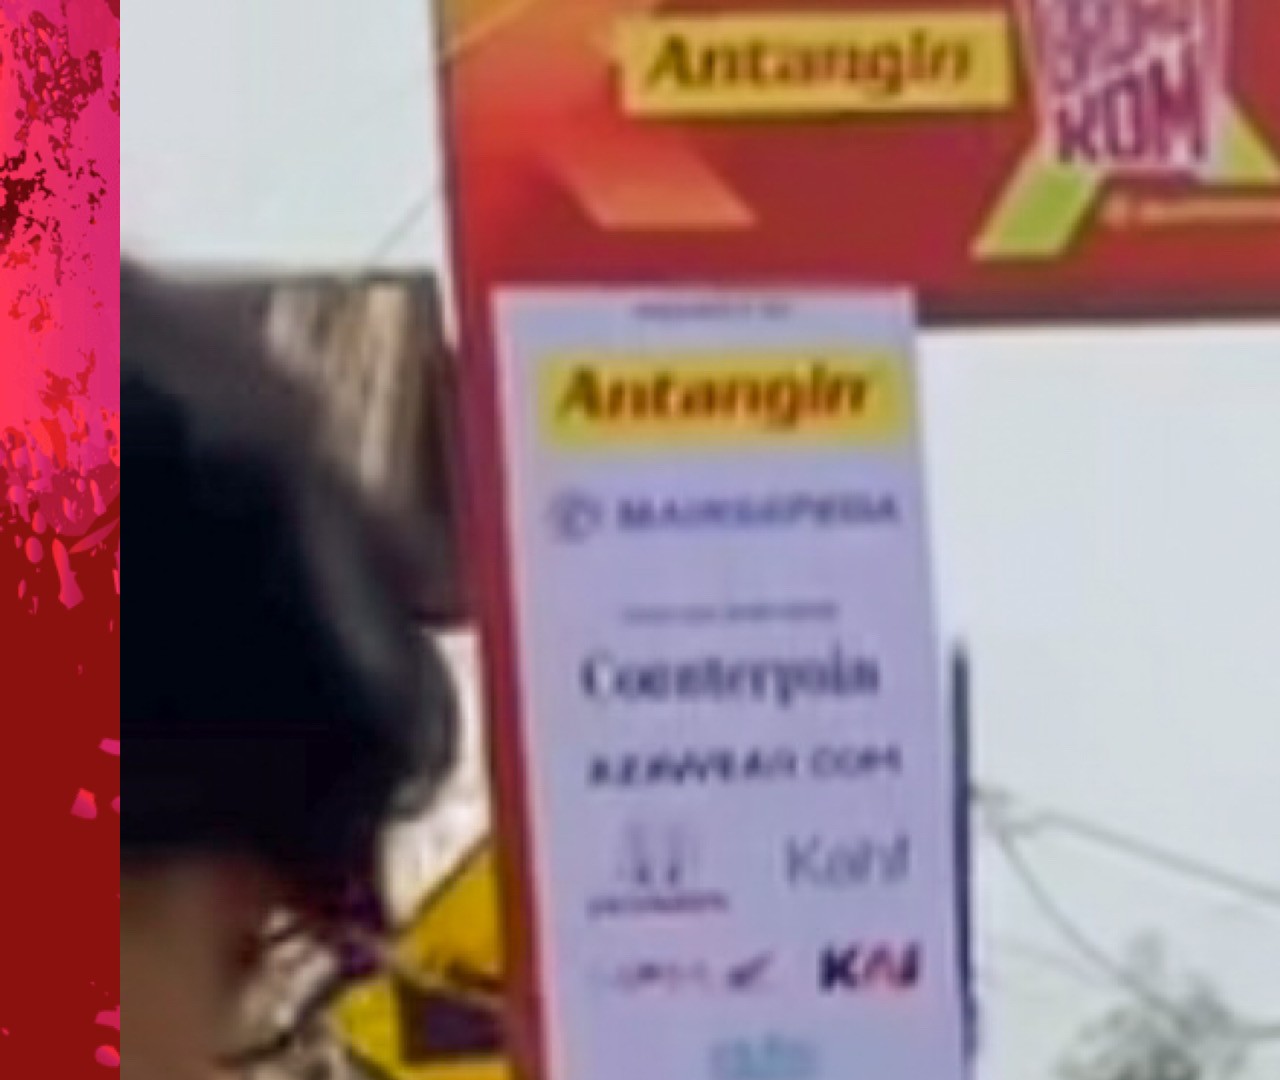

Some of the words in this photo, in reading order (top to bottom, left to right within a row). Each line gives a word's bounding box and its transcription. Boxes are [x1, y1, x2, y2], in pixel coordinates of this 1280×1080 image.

[644, 30, 970, 97] Antangin
[1056, 44, 1207, 165] KOM
[554, 361, 870, 431] Antangin
